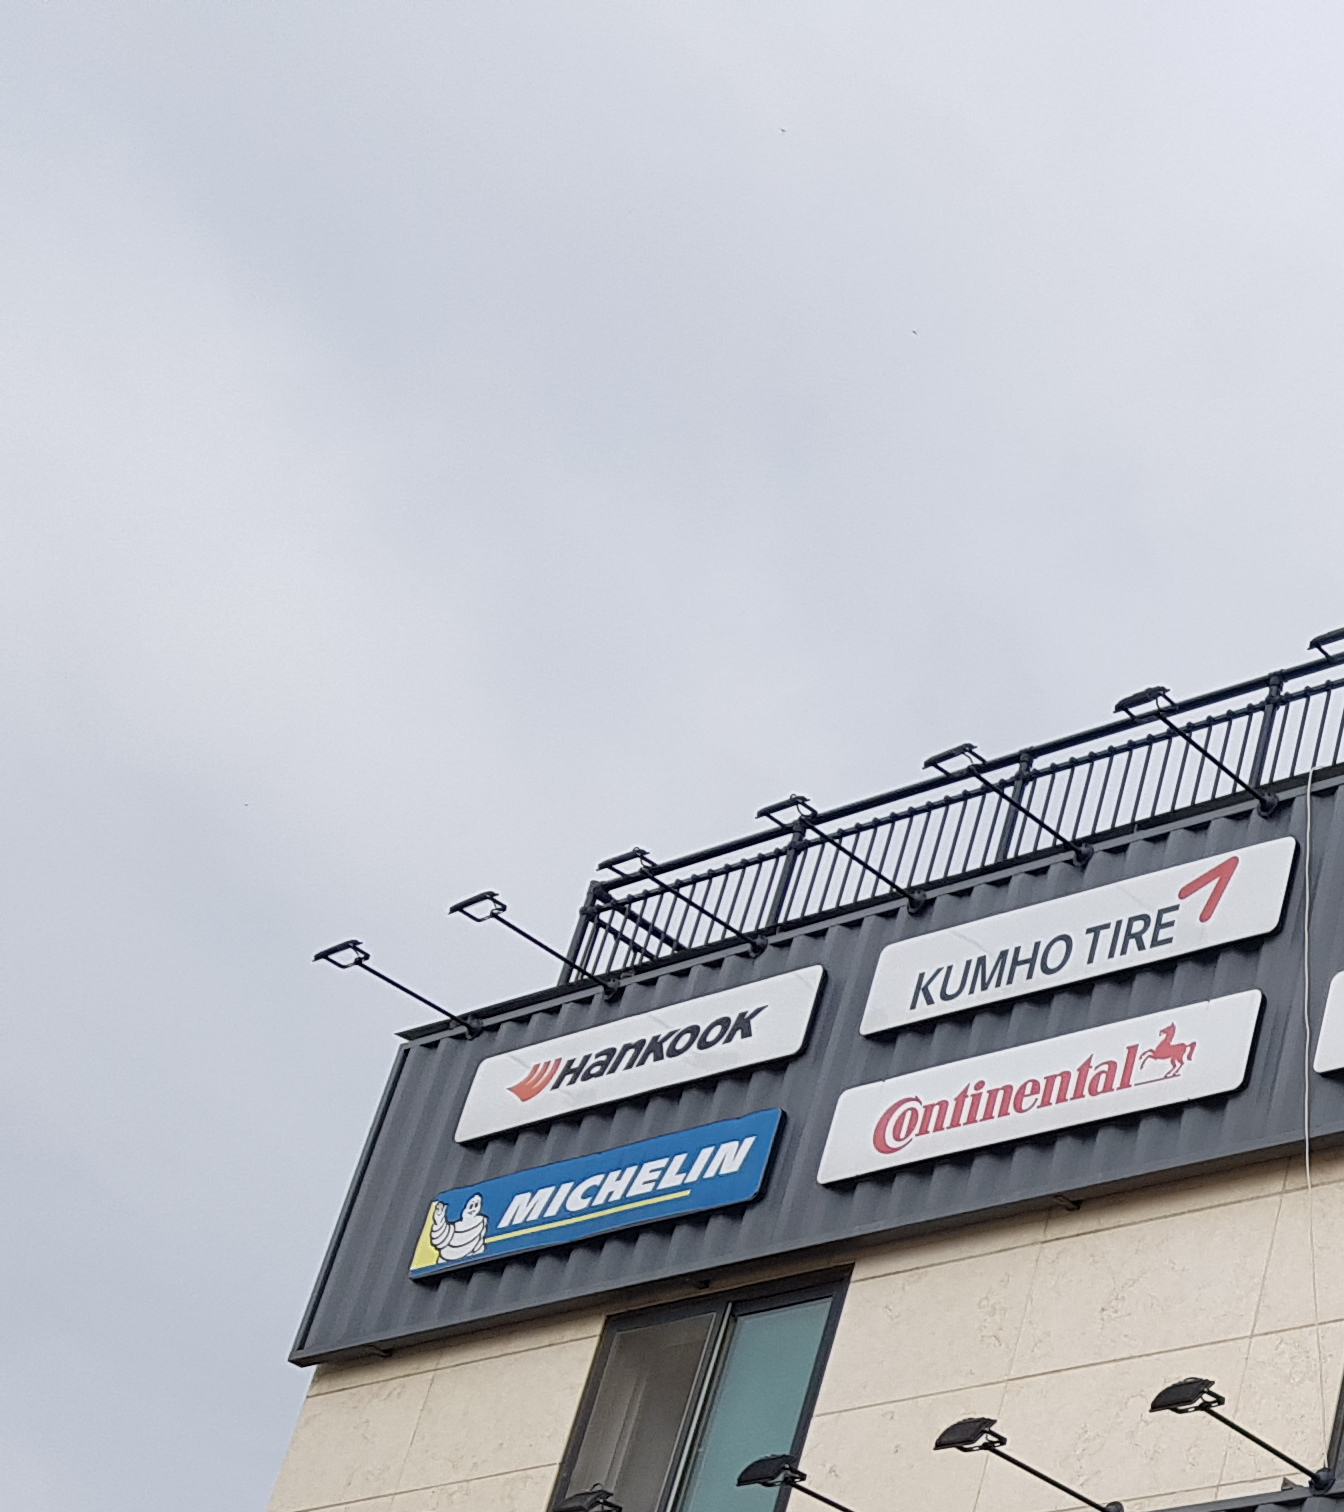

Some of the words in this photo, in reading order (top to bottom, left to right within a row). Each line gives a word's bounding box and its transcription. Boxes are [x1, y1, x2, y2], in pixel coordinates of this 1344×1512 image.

[908, 933, 1075, 1011] KUMHO
[1084, 904, 1180, 966] TIRE
[872, 1043, 1143, 1155] Continental
[496, 1135, 758, 1230] MICHELIN
